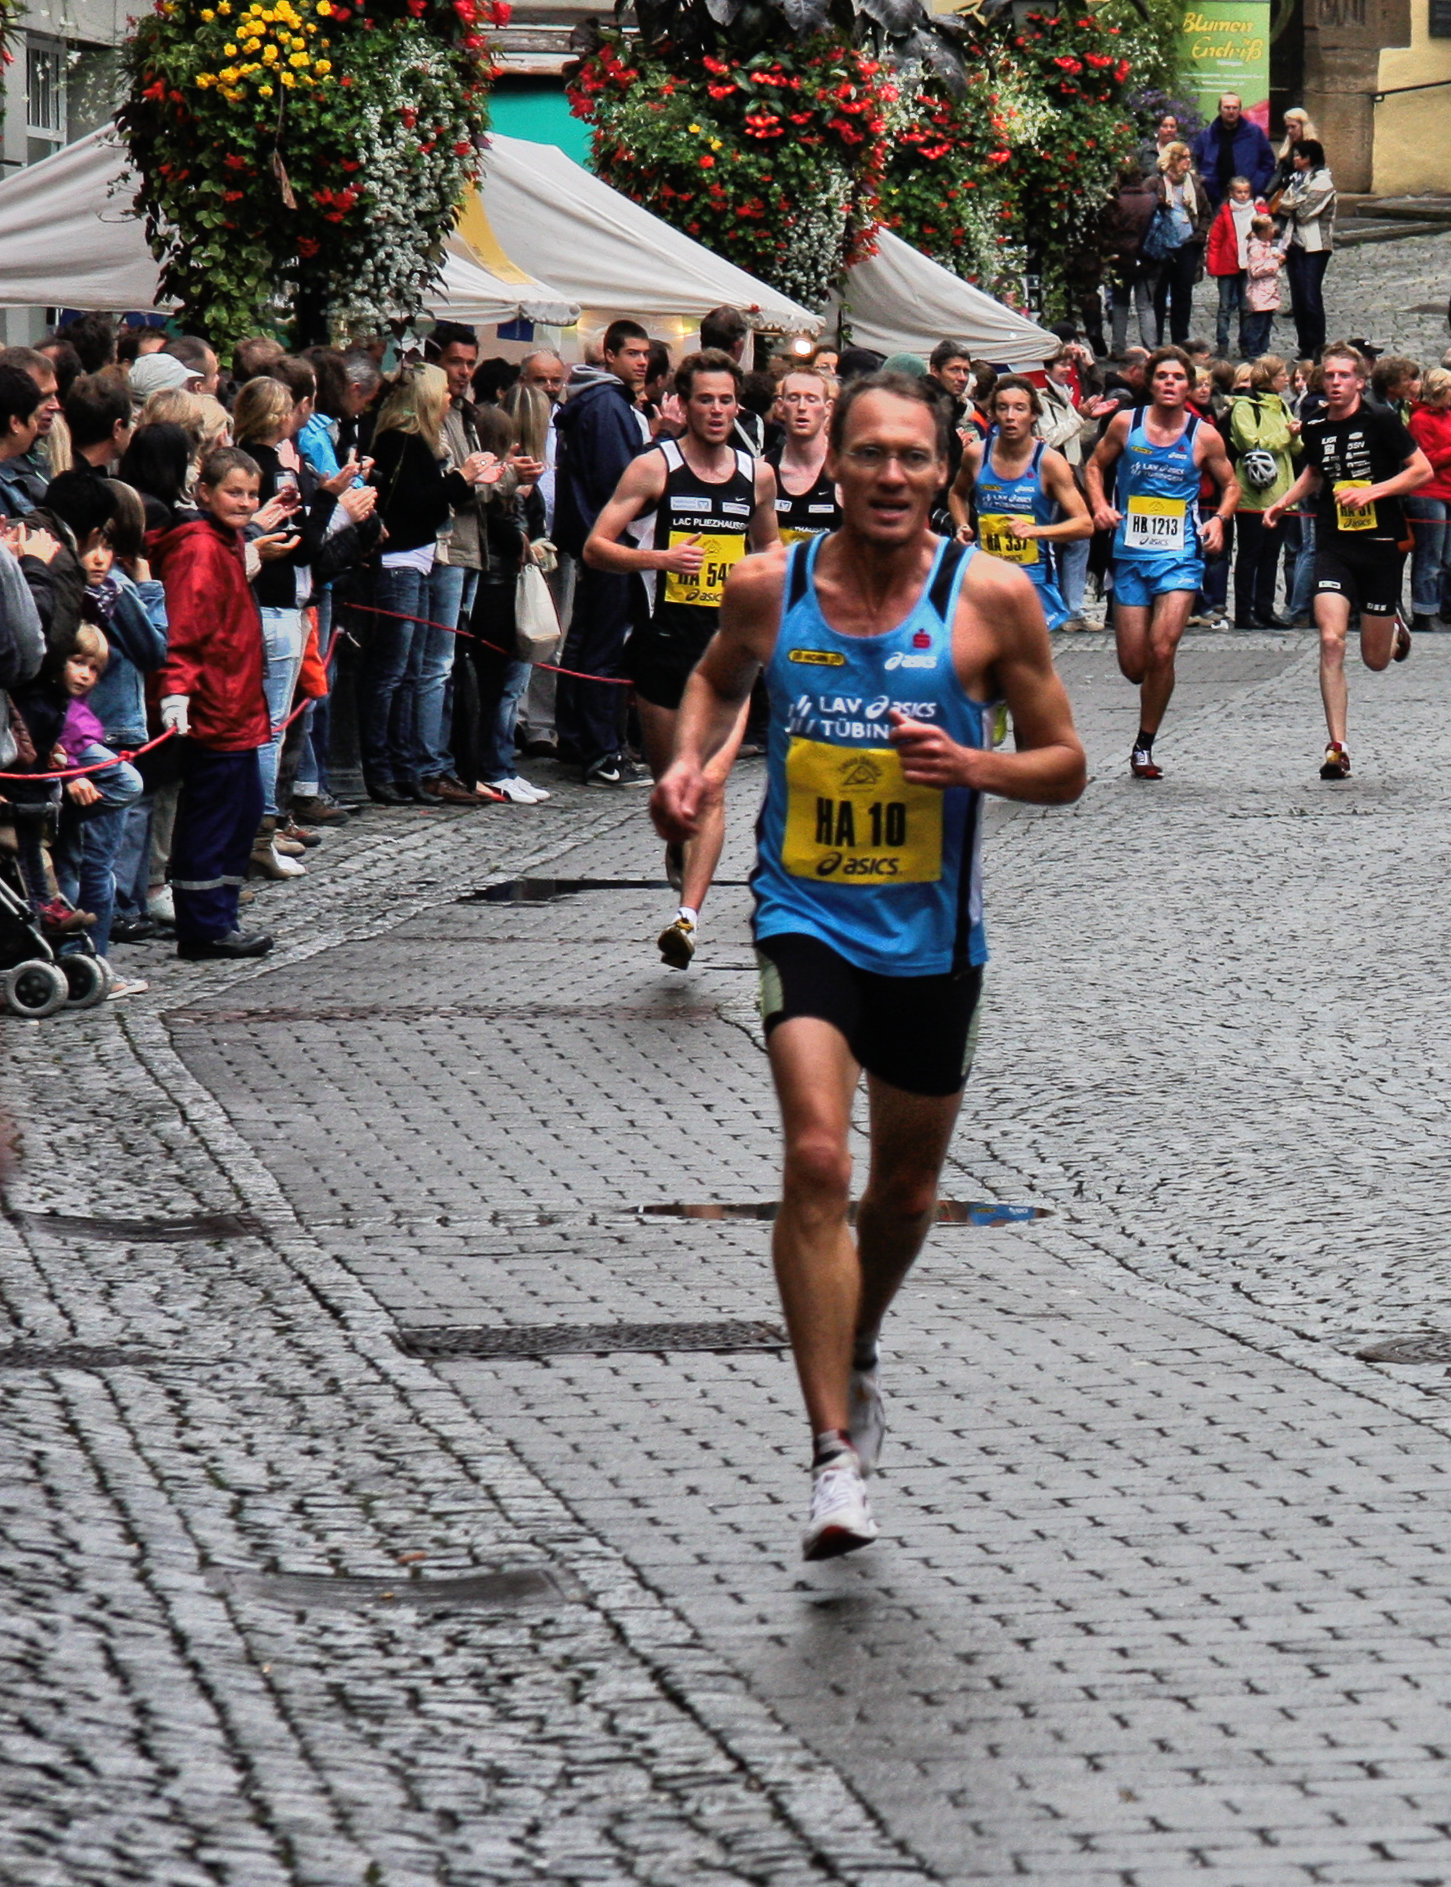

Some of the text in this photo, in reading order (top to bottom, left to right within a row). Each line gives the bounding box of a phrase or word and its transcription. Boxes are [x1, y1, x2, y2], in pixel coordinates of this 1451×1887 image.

[1183, 12, 1255, 33] Blumen
[673, 518, 691, 526] LAC
[1133, 515, 1178, 535] HB 1213
[707, 562, 735, 587] 54
[819, 696, 862, 714] LAV
[820, 718, 890, 740] TÜBIN
[815, 797, 906, 847] HA 10
[843, 857, 899, 875] asics
